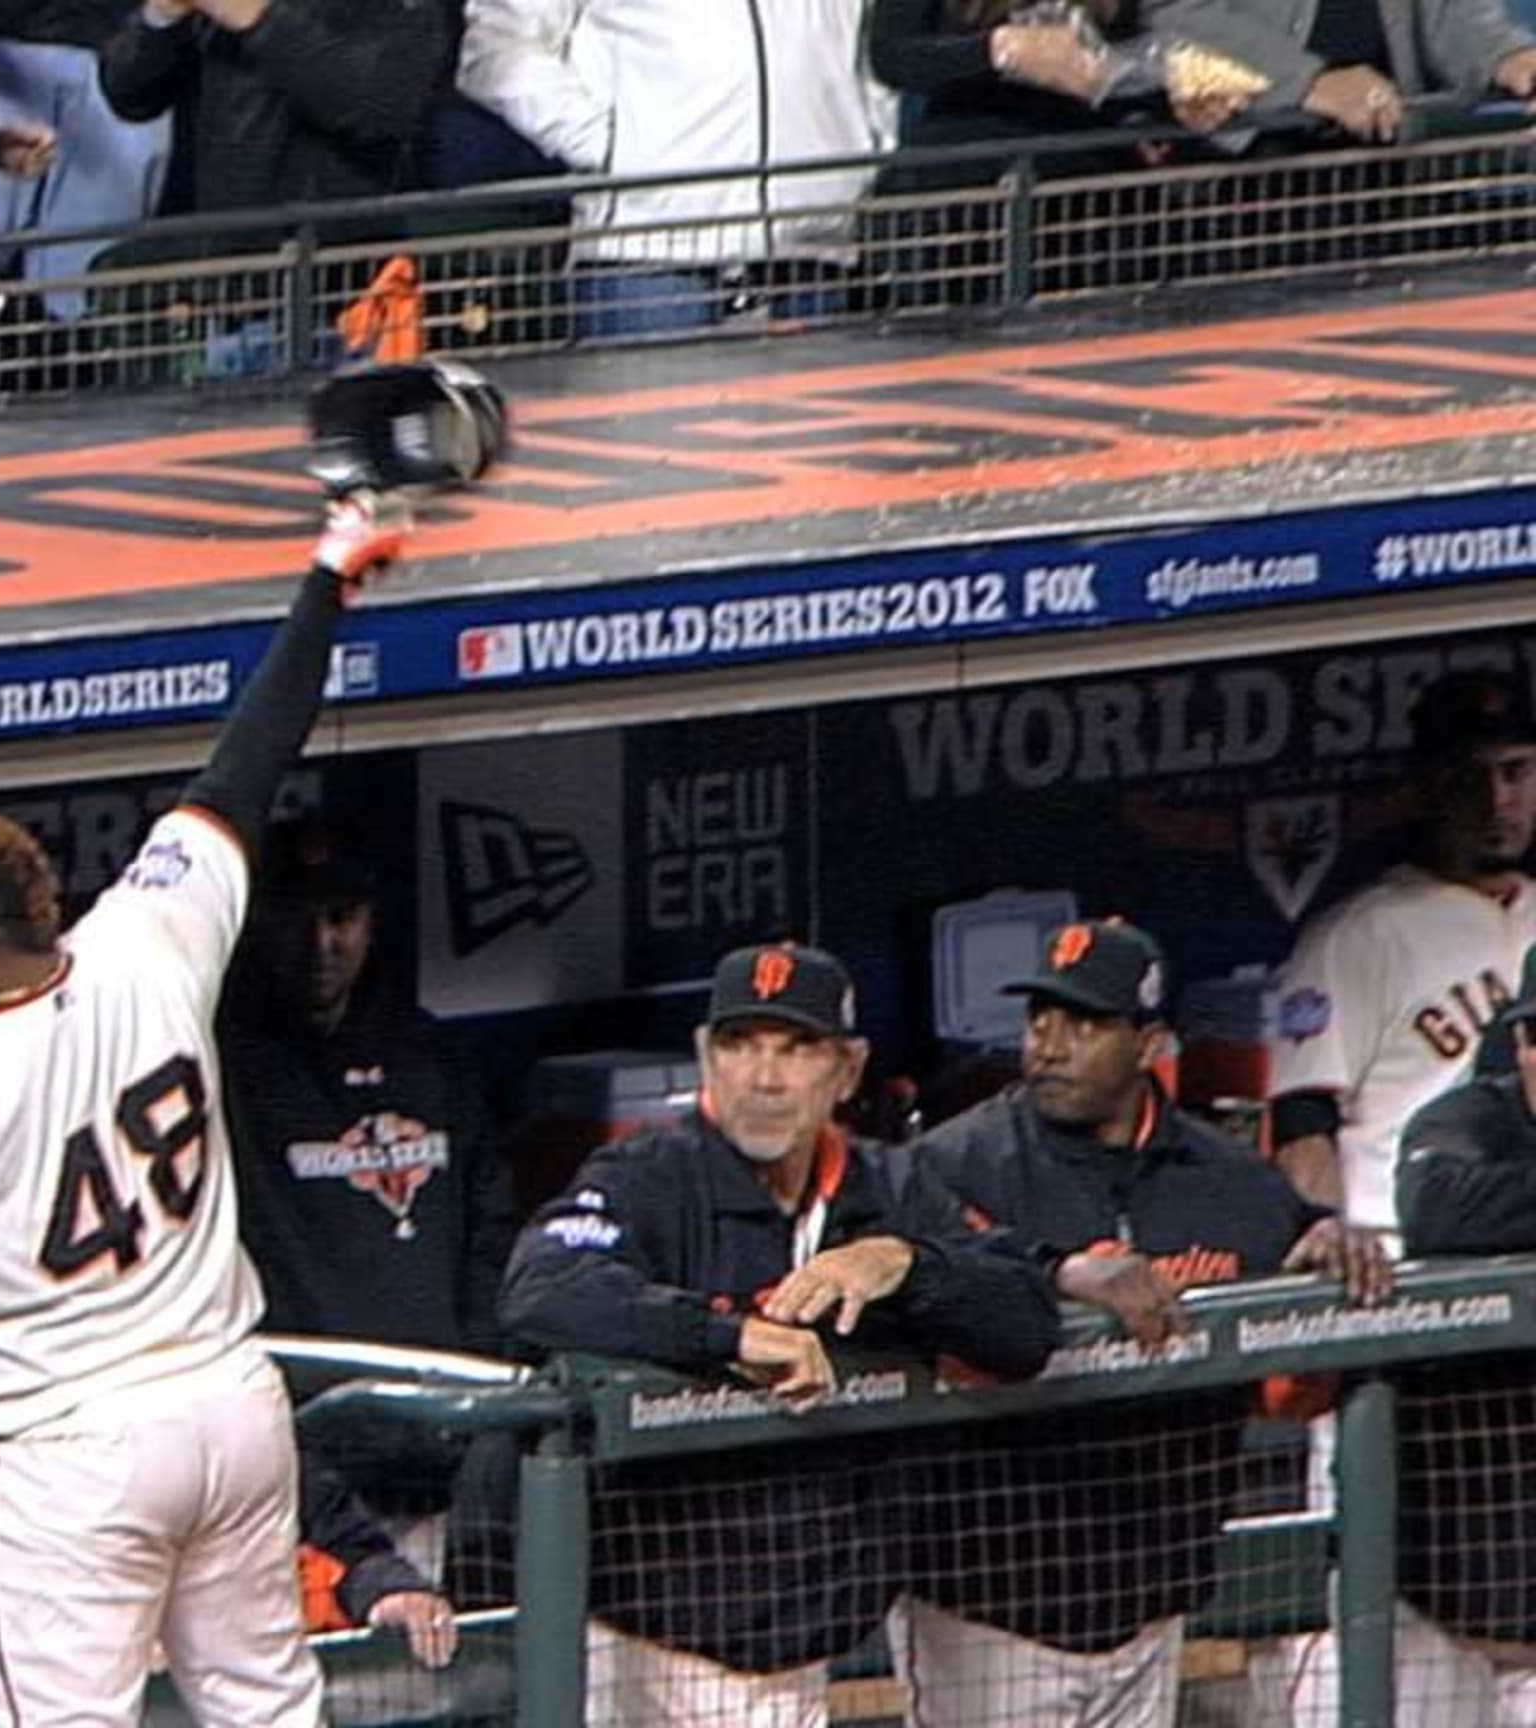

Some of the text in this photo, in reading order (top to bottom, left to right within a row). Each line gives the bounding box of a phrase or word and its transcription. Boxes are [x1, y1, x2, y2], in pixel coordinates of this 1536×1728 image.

[1147, 554, 1319, 608] sfgiants.com
[1374, 522, 1536, 581] #WORL
[1023, 566, 1098, 616] FOX
[889, 667, 1293, 799] WORLD
[647, 762, 788, 855] NEW
[647, 845, 787, 930] ERA
[38, 1052, 207, 1284] 48
[1237, 1292, 1512, 1354] bankofamerica.com
